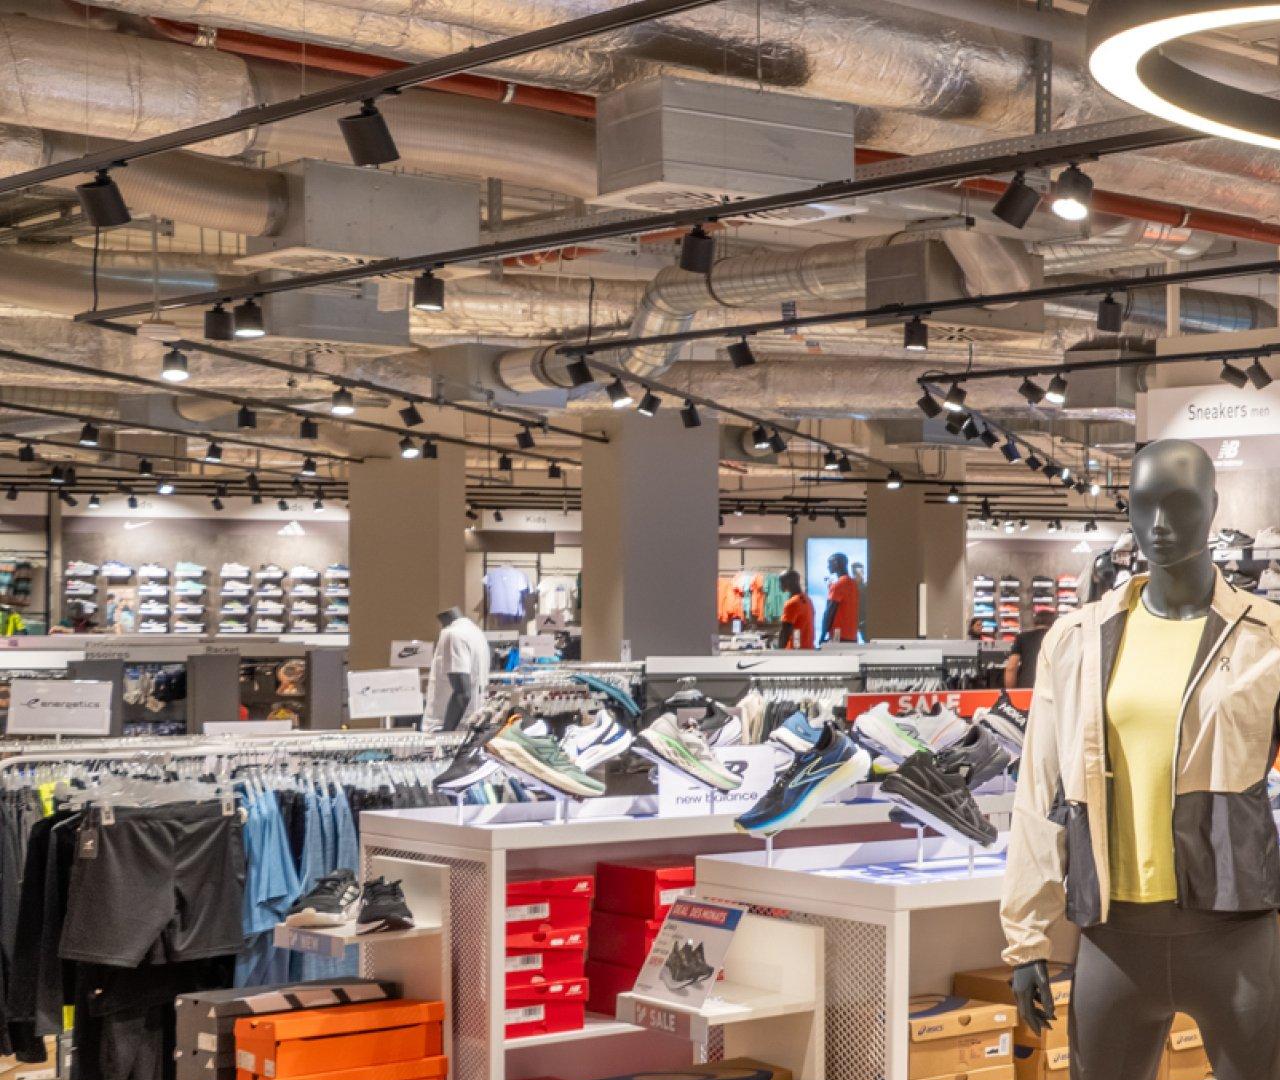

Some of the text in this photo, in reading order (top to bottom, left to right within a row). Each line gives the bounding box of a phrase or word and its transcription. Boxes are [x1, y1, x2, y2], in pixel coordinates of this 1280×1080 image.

[1188, 402, 1270, 421] Sneakers men
[40, 698, 100, 709] energetics
[675, 791, 758, 805] new balance
[649, 1011, 677, 1033] SALE
